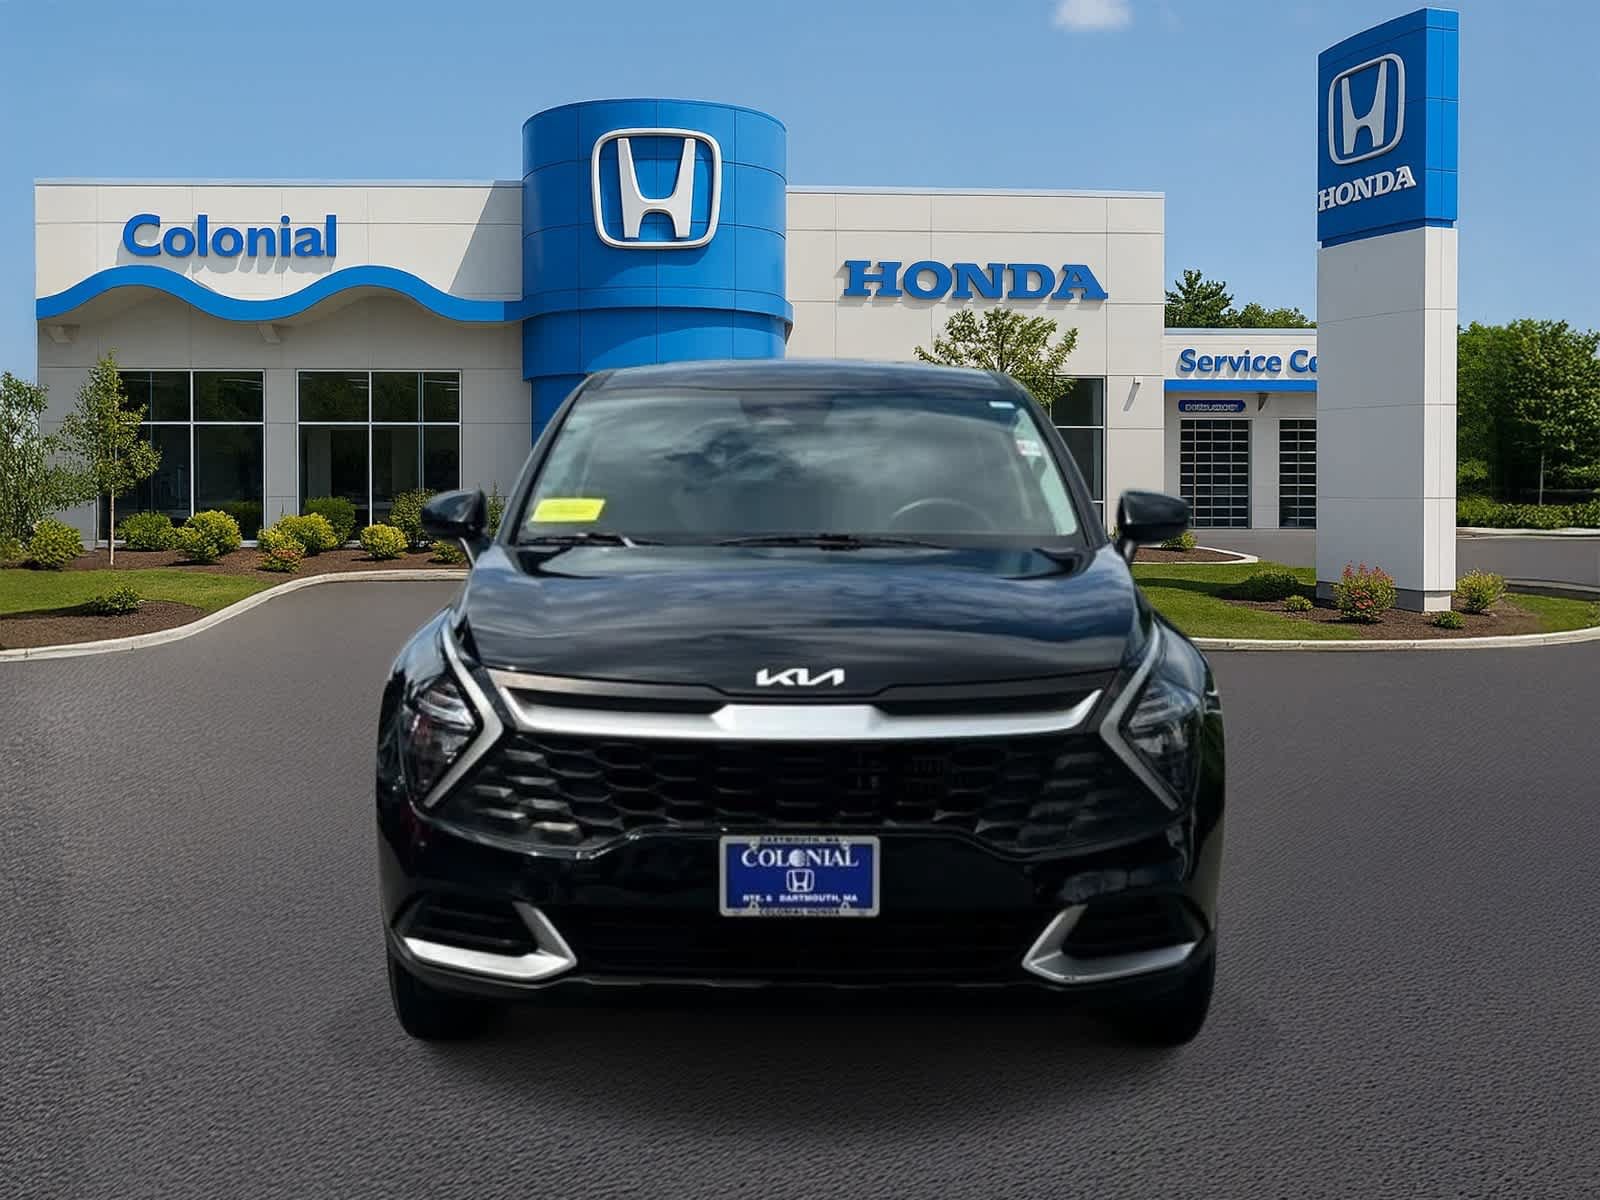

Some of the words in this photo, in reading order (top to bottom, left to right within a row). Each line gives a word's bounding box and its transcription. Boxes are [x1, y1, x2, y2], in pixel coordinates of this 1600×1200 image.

[1318, 165, 1417, 212] HONDA
[123, 213, 337, 257] Colonial
[843, 260, 1109, 300] HONDA
[1180, 348, 1282, 373] Service
[741, 849, 859, 867] COLONIAL
[779, 894, 841, 903] DARTMOUTH,
[843, 894, 858, 902] MA
